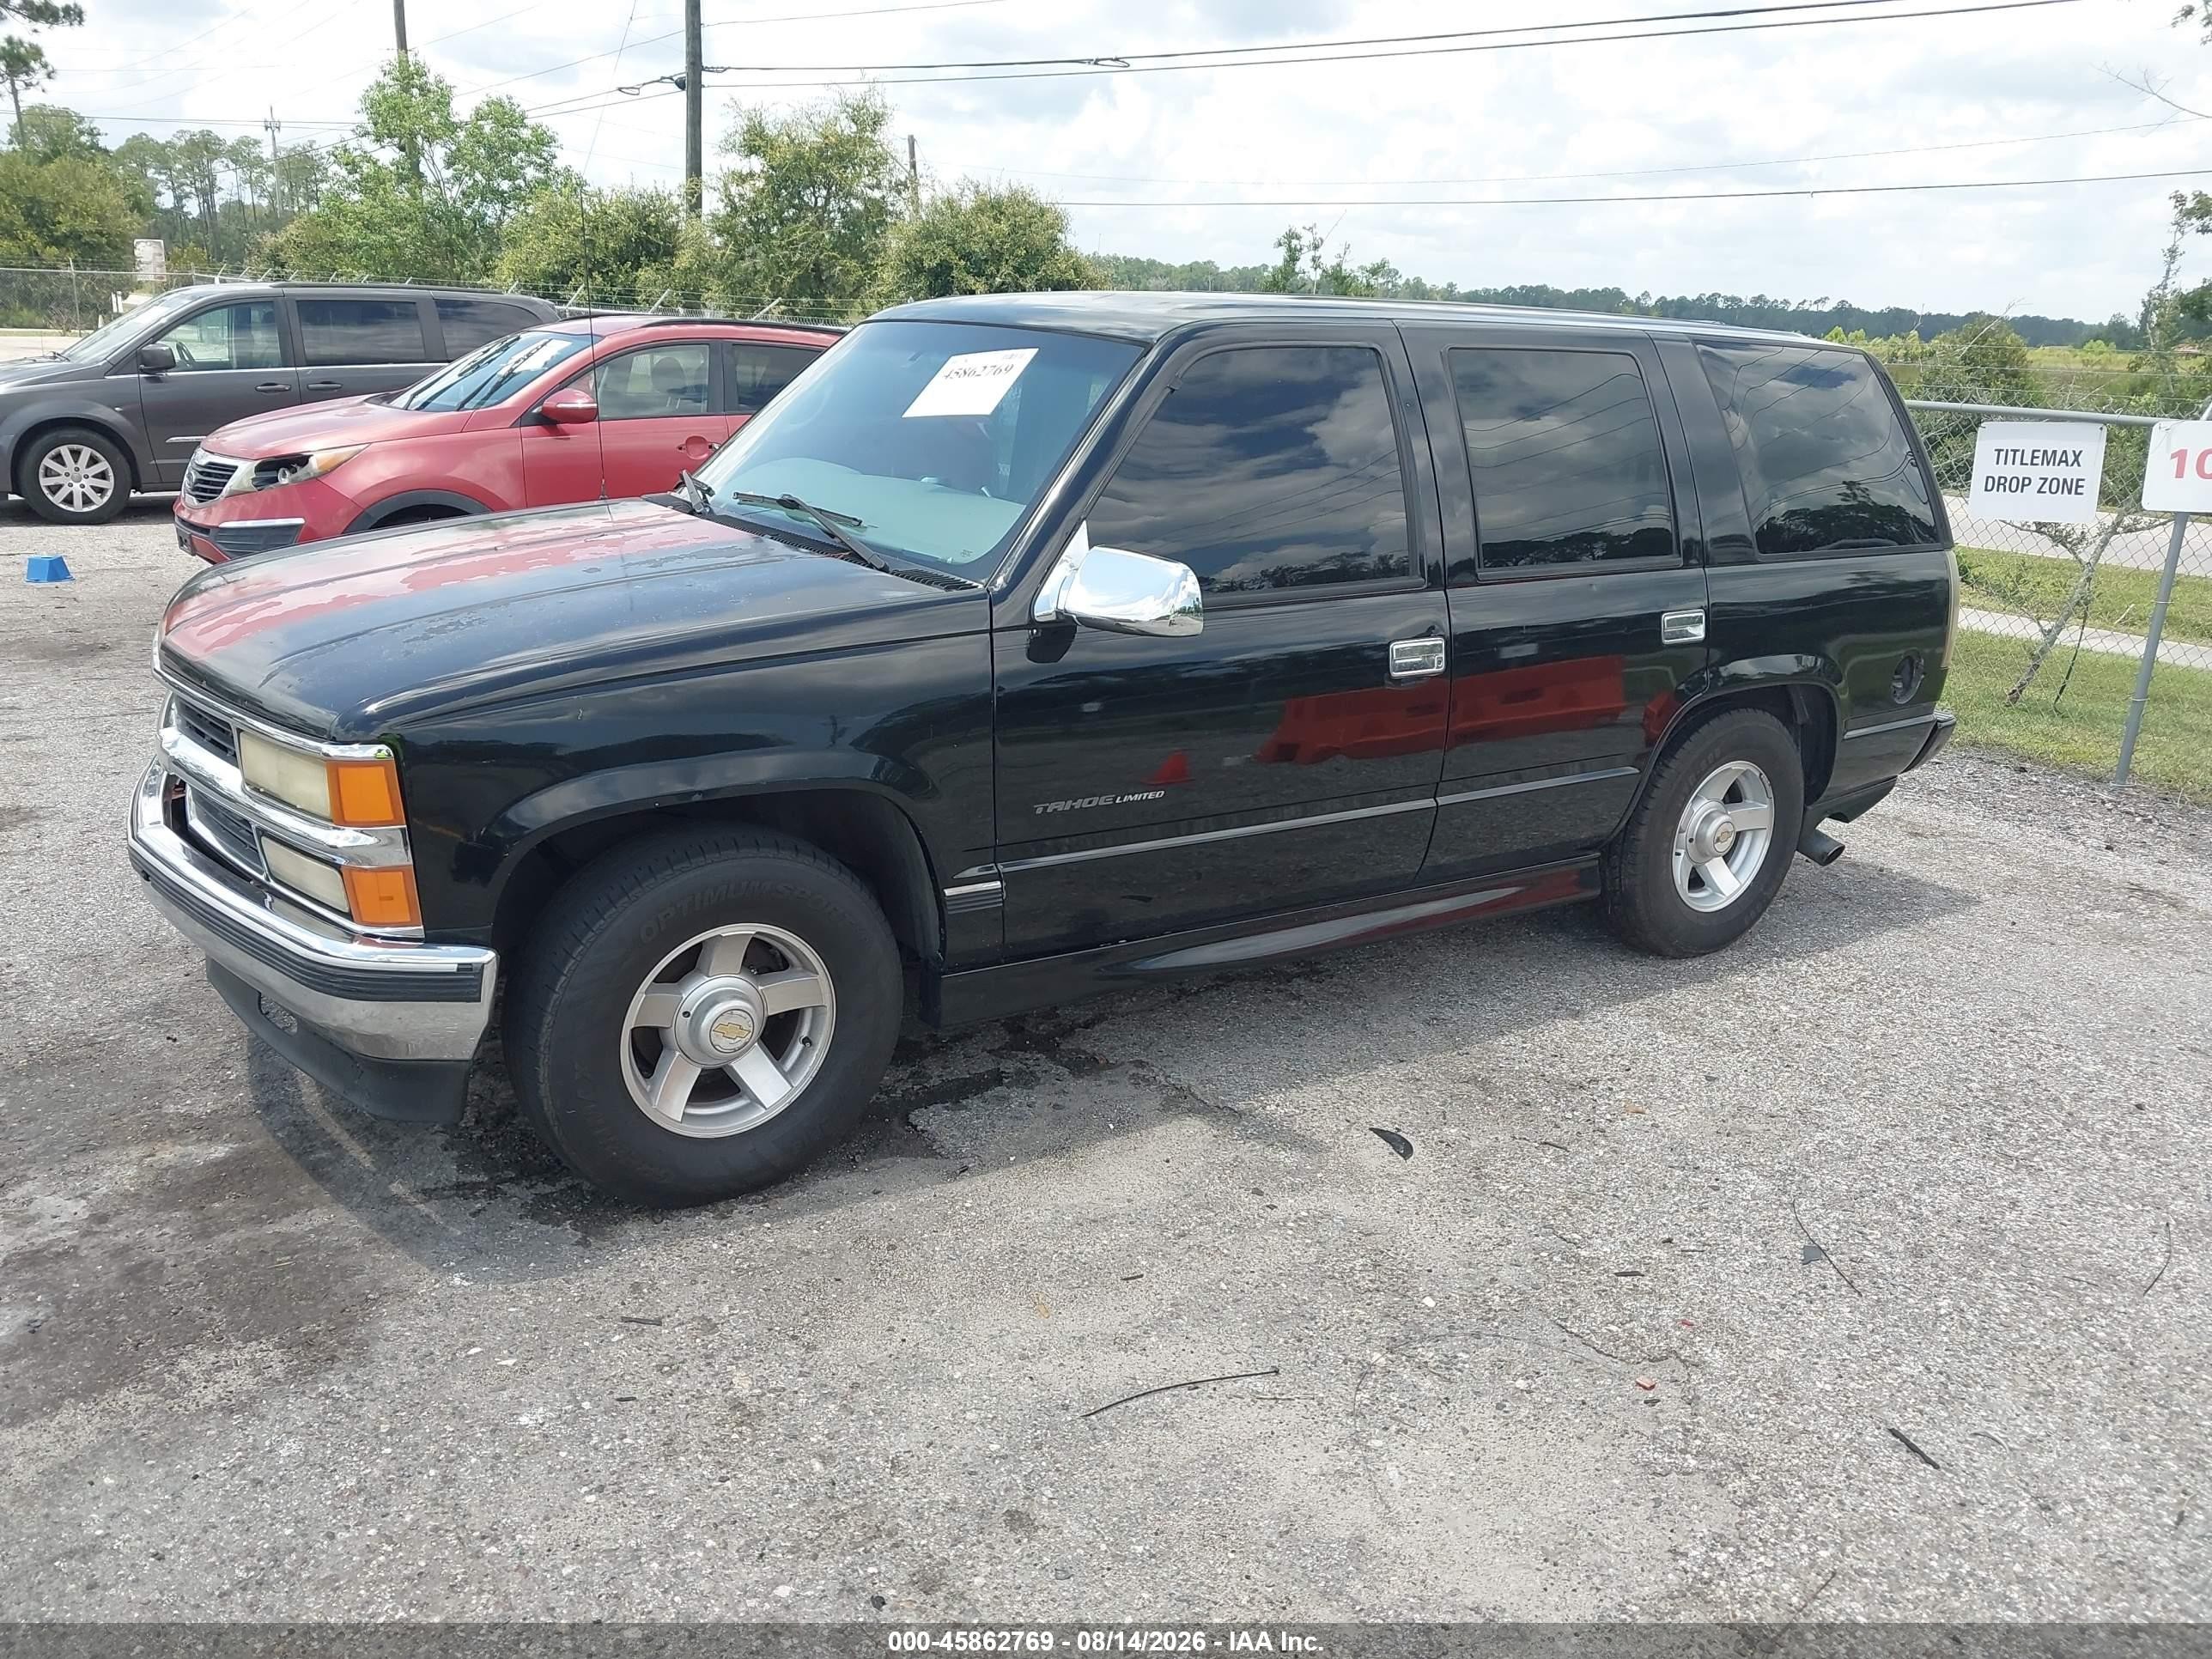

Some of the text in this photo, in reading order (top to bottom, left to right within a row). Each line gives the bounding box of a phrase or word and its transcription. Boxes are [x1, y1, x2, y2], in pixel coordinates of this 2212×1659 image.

[943, 363, 1014, 380] 45862769
[1994, 448, 2083, 467] TITLEMAX
[1984, 476, 2086, 495] DROP ZONE
[1033, 790, 1164, 815] TAHOE LIMITED
